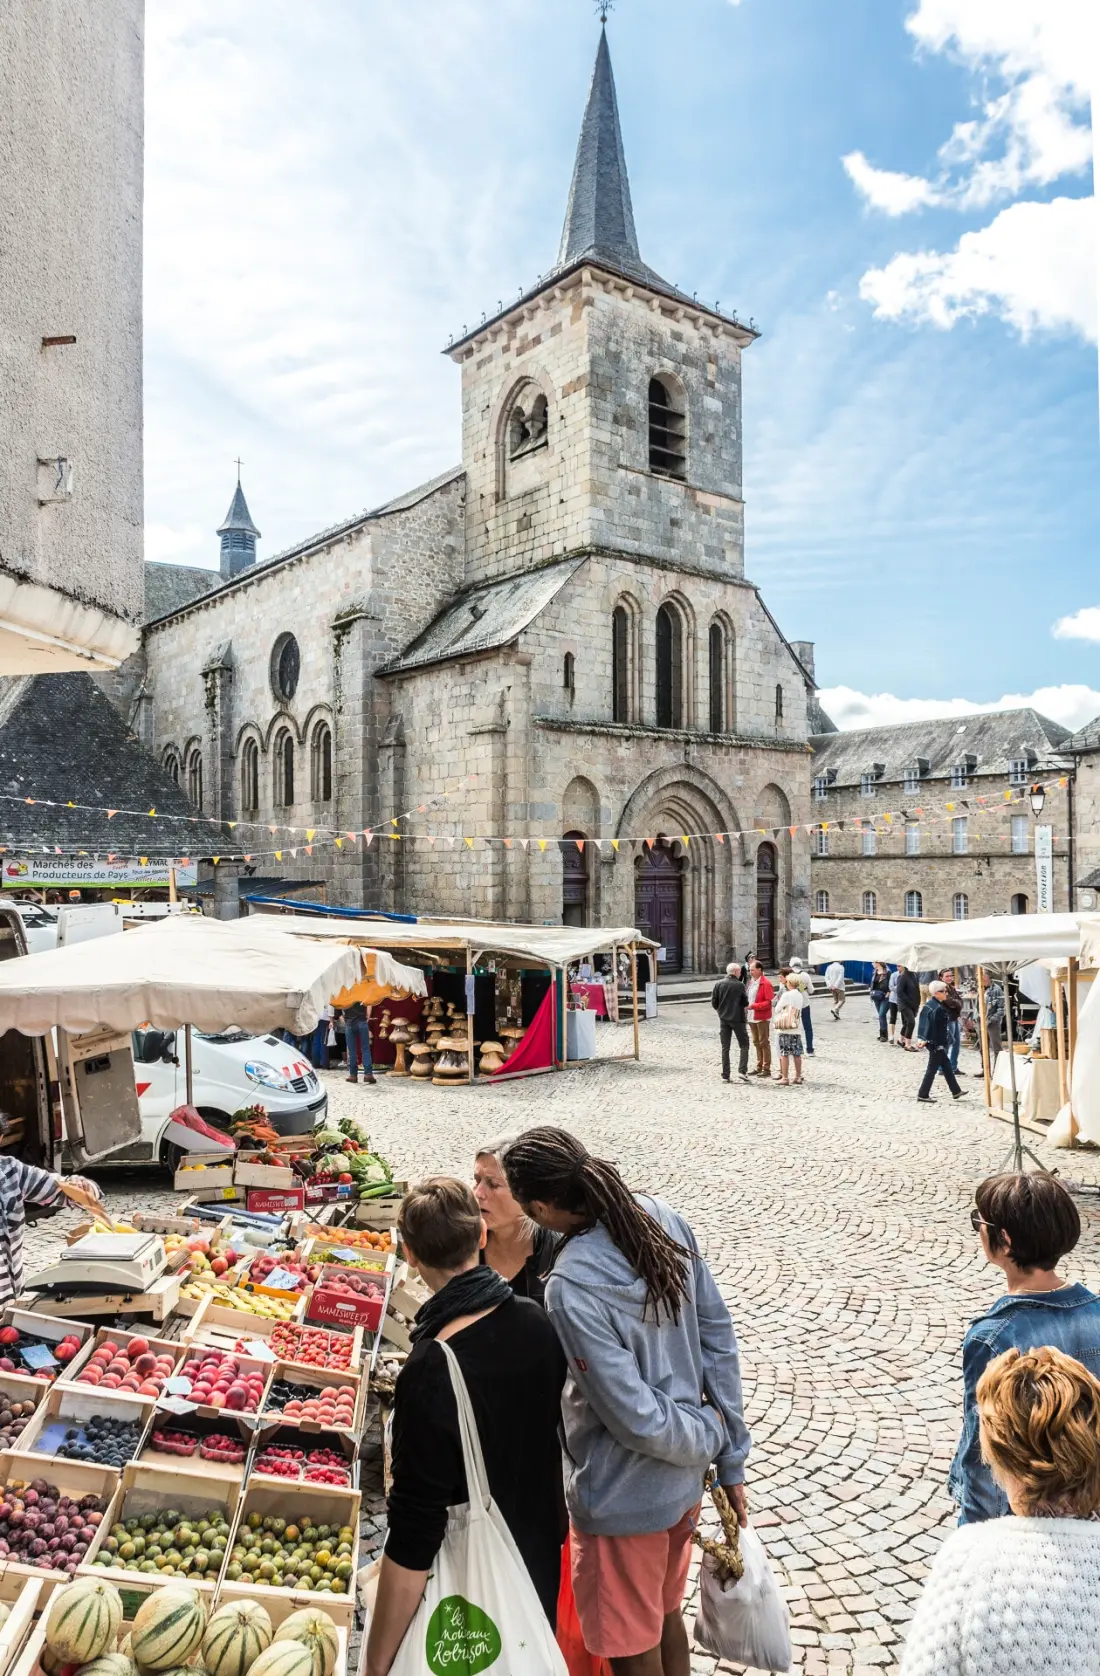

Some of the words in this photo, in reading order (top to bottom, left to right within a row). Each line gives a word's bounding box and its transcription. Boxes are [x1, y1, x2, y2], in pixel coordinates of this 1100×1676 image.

[33, 860, 75, 869] Marchés
[77, 860, 94, 869] des
[32, 871, 92, 879] Producteurs
[94, 871, 105, 879] de
[108, 871, 128, 881] Pays
[255, 1200, 293, 1208] NAMISWE
